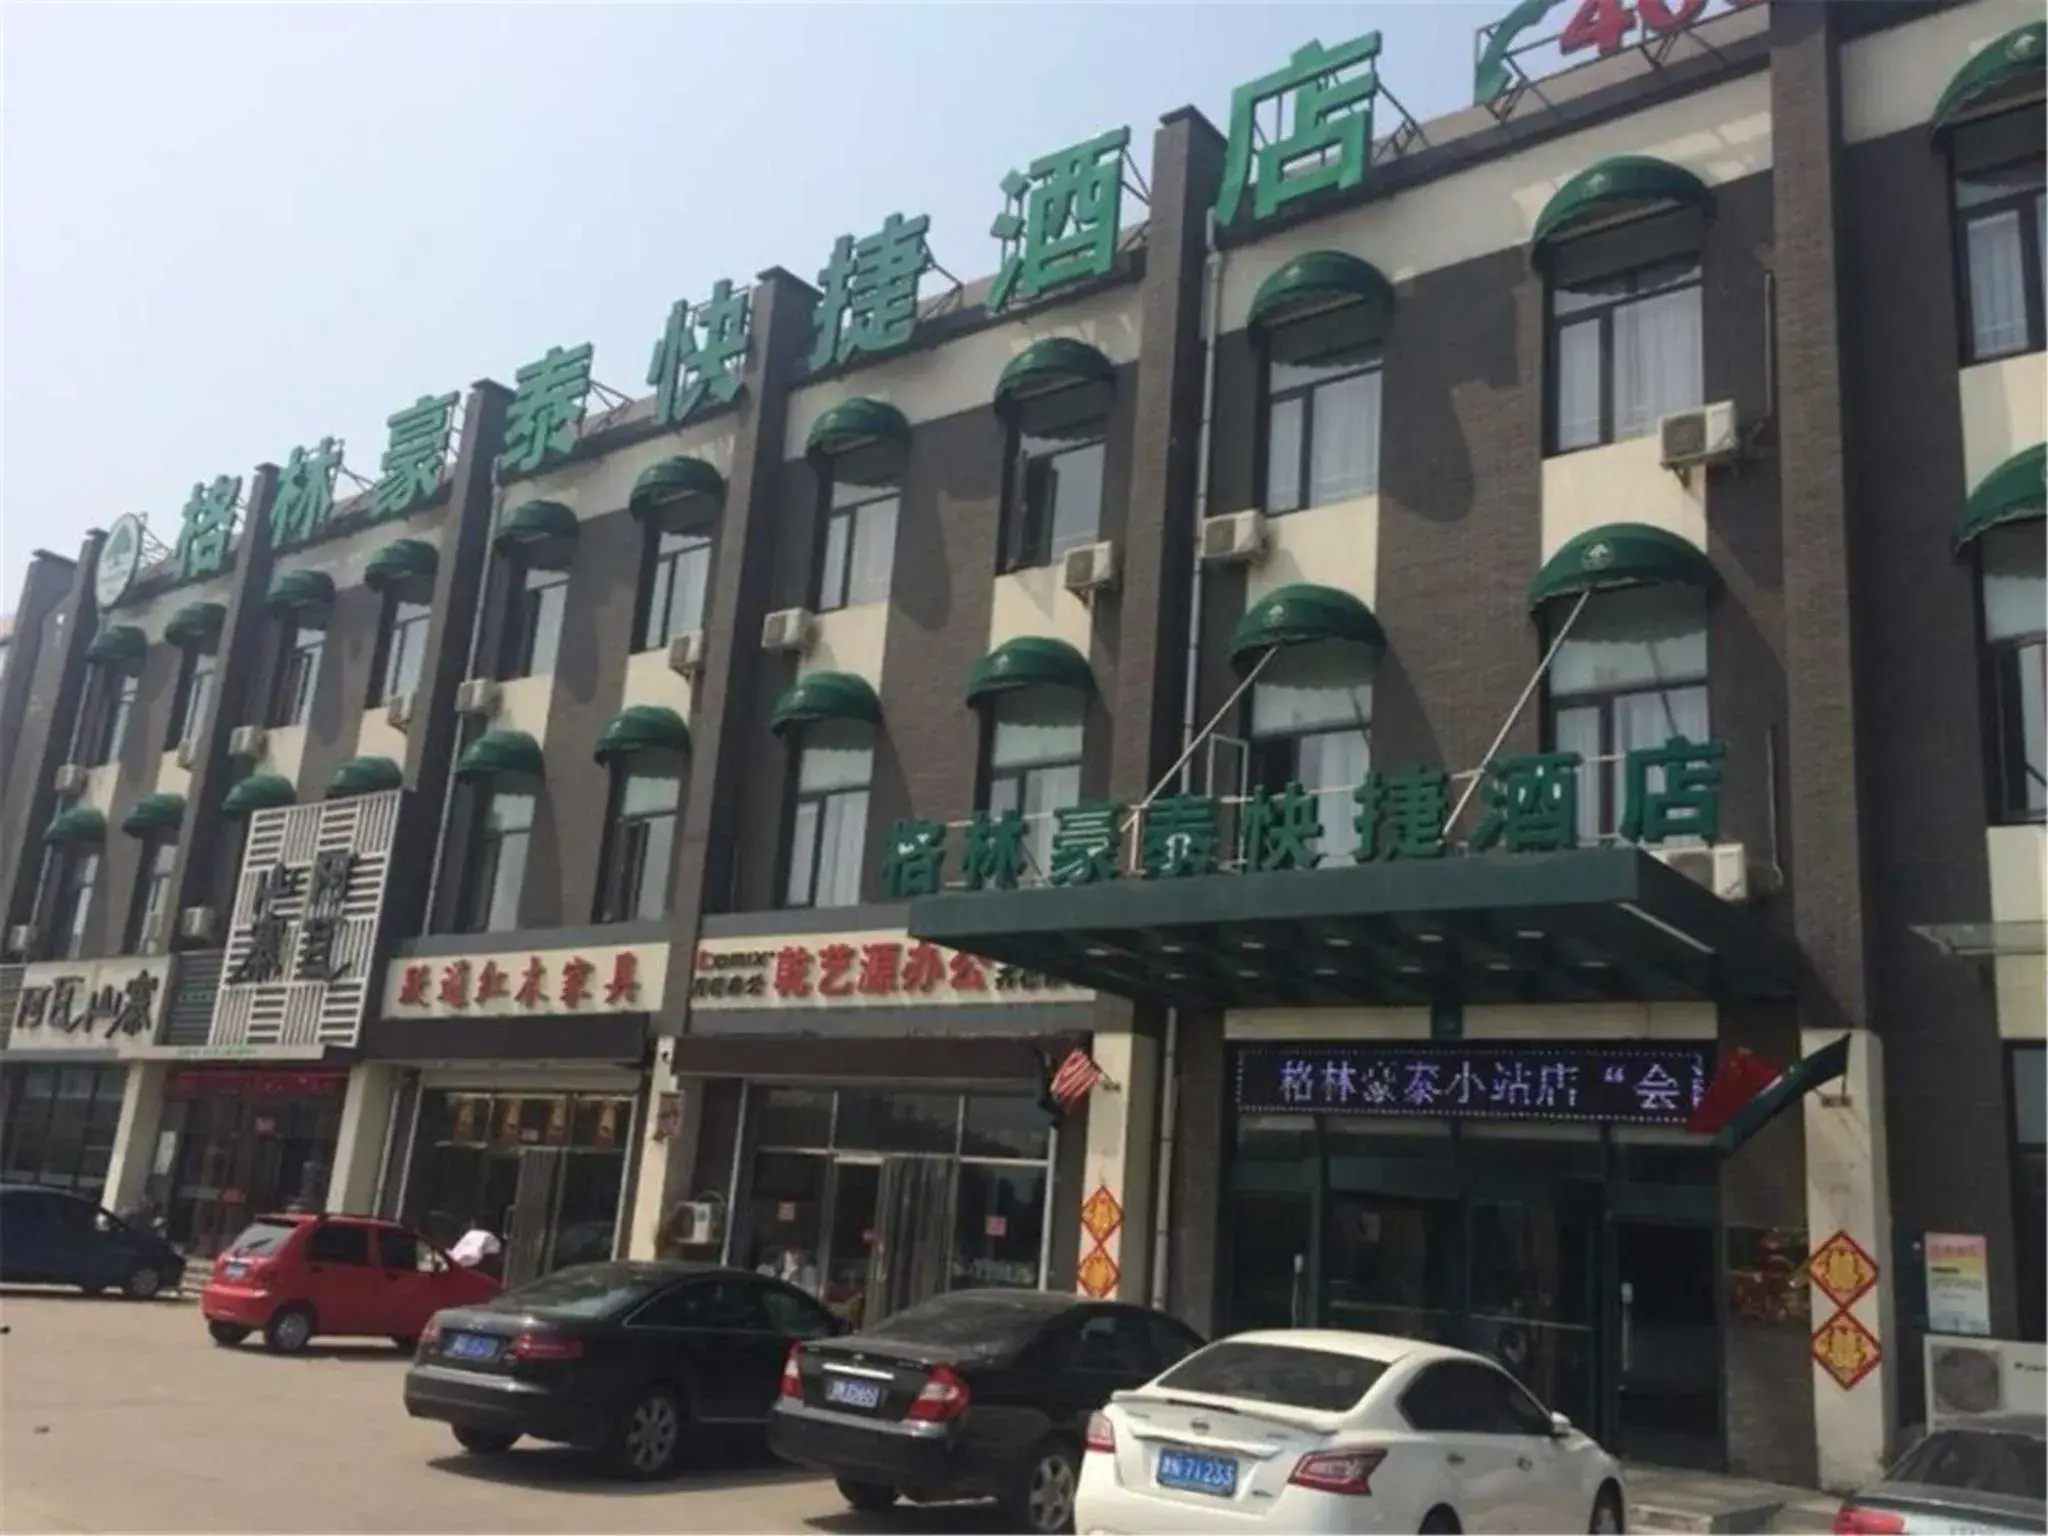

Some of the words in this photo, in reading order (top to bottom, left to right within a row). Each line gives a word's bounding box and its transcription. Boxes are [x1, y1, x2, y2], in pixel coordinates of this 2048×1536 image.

[174, 30, 1382, 579] 格林豪泰快捷酒店
[880, 737, 1729, 897] 格林豪泰快捷酒店
